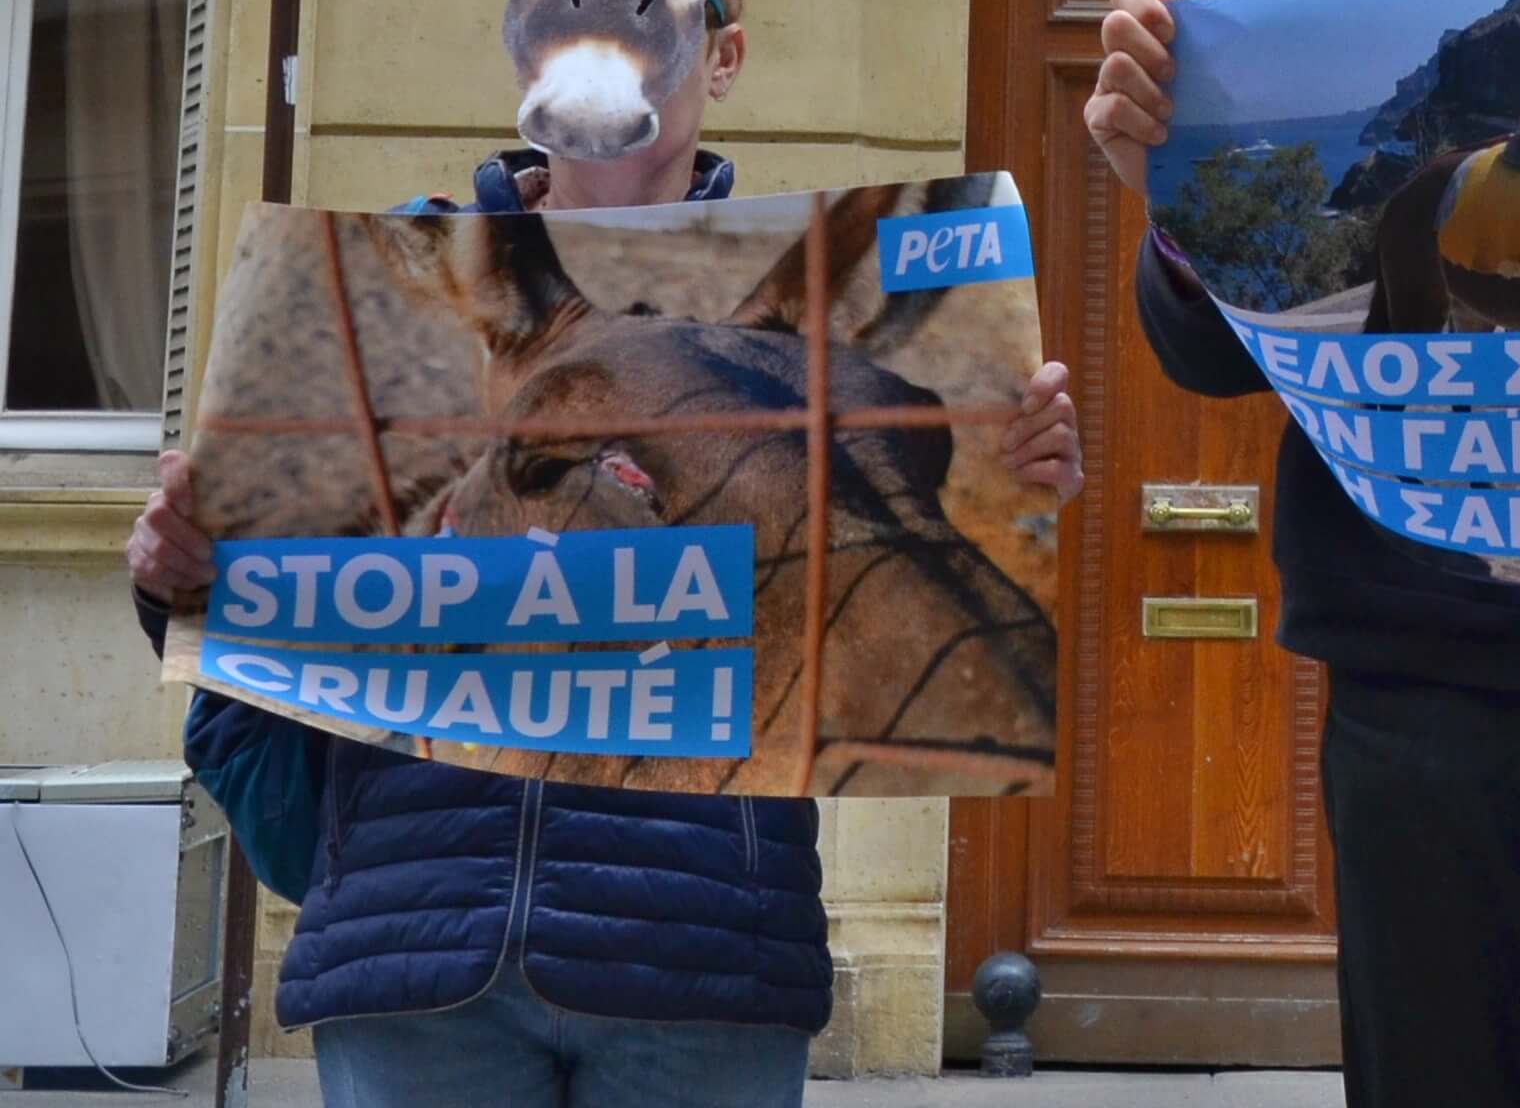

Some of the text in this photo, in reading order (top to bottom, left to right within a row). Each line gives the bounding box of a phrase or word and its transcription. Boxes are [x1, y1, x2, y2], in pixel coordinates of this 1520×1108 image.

[222, 526, 730, 630] STOP À LA
[215, 640, 733, 742] CRUAUTÉ !
